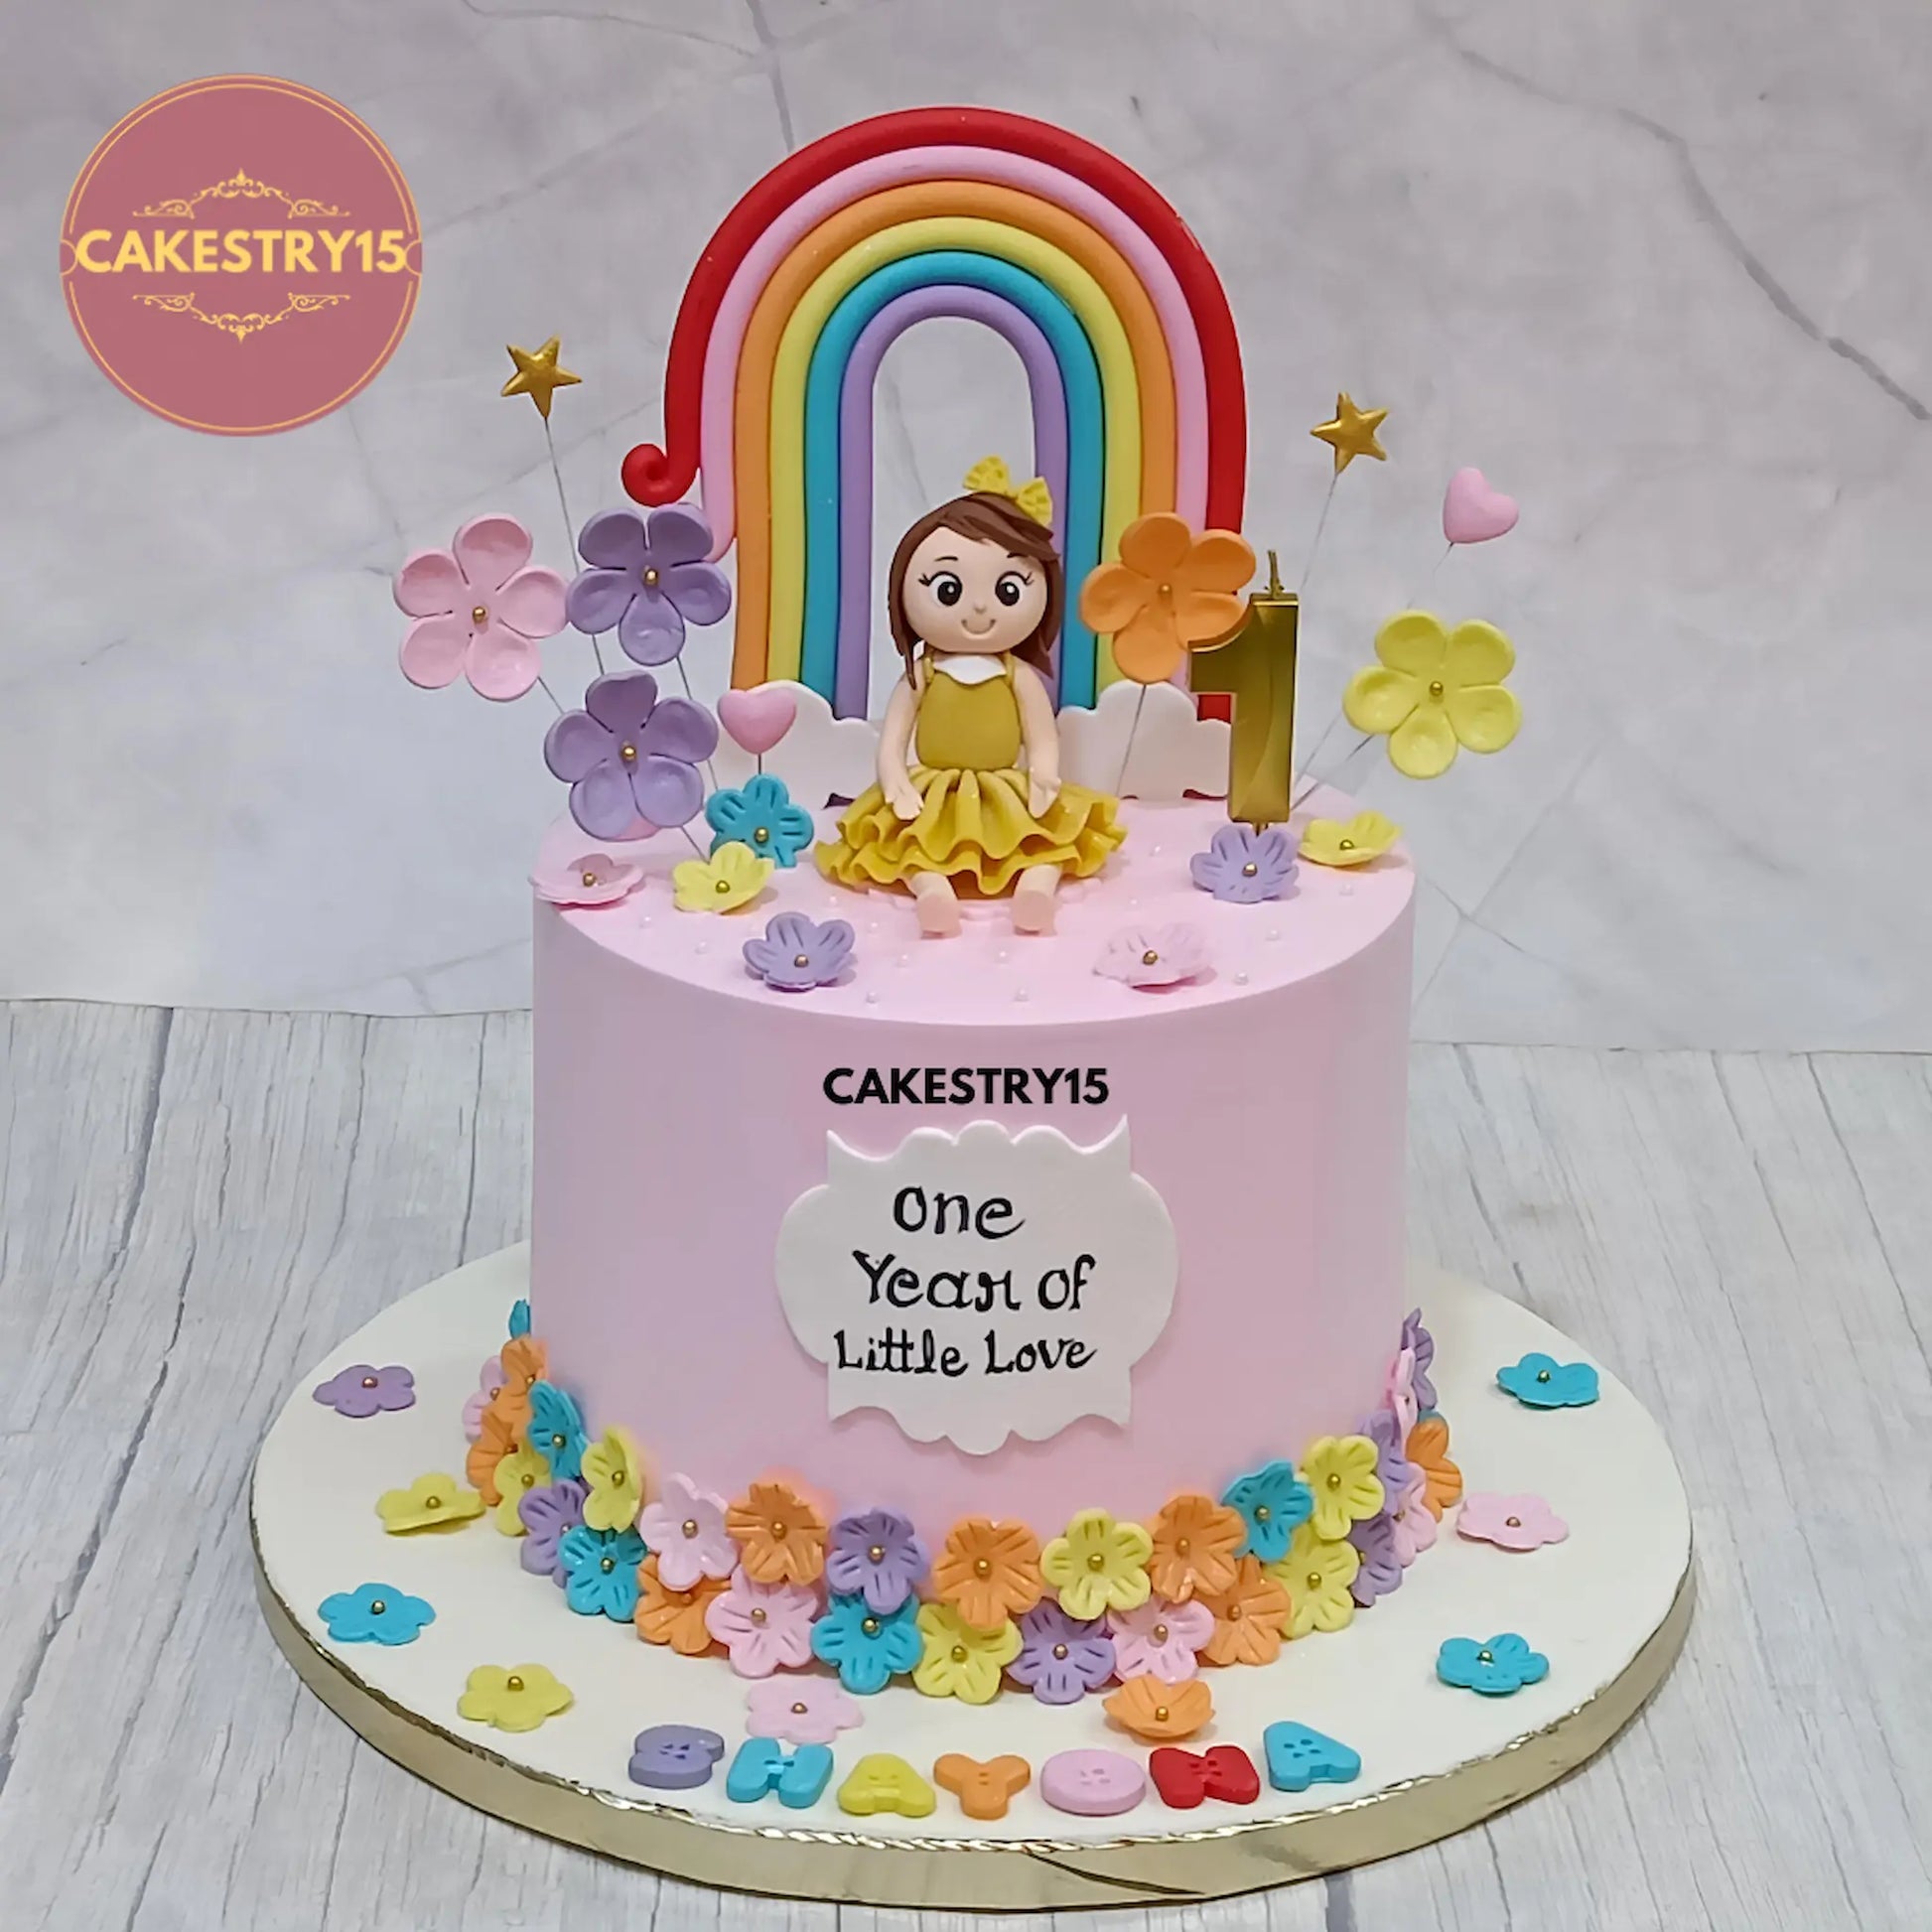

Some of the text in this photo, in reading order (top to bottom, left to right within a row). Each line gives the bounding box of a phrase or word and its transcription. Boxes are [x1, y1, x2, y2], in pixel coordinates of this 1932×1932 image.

[893, 1185, 1027, 1240] One
[851, 1249, 1022, 1312] Year
[832, 1326, 1099, 1377] Little Love
